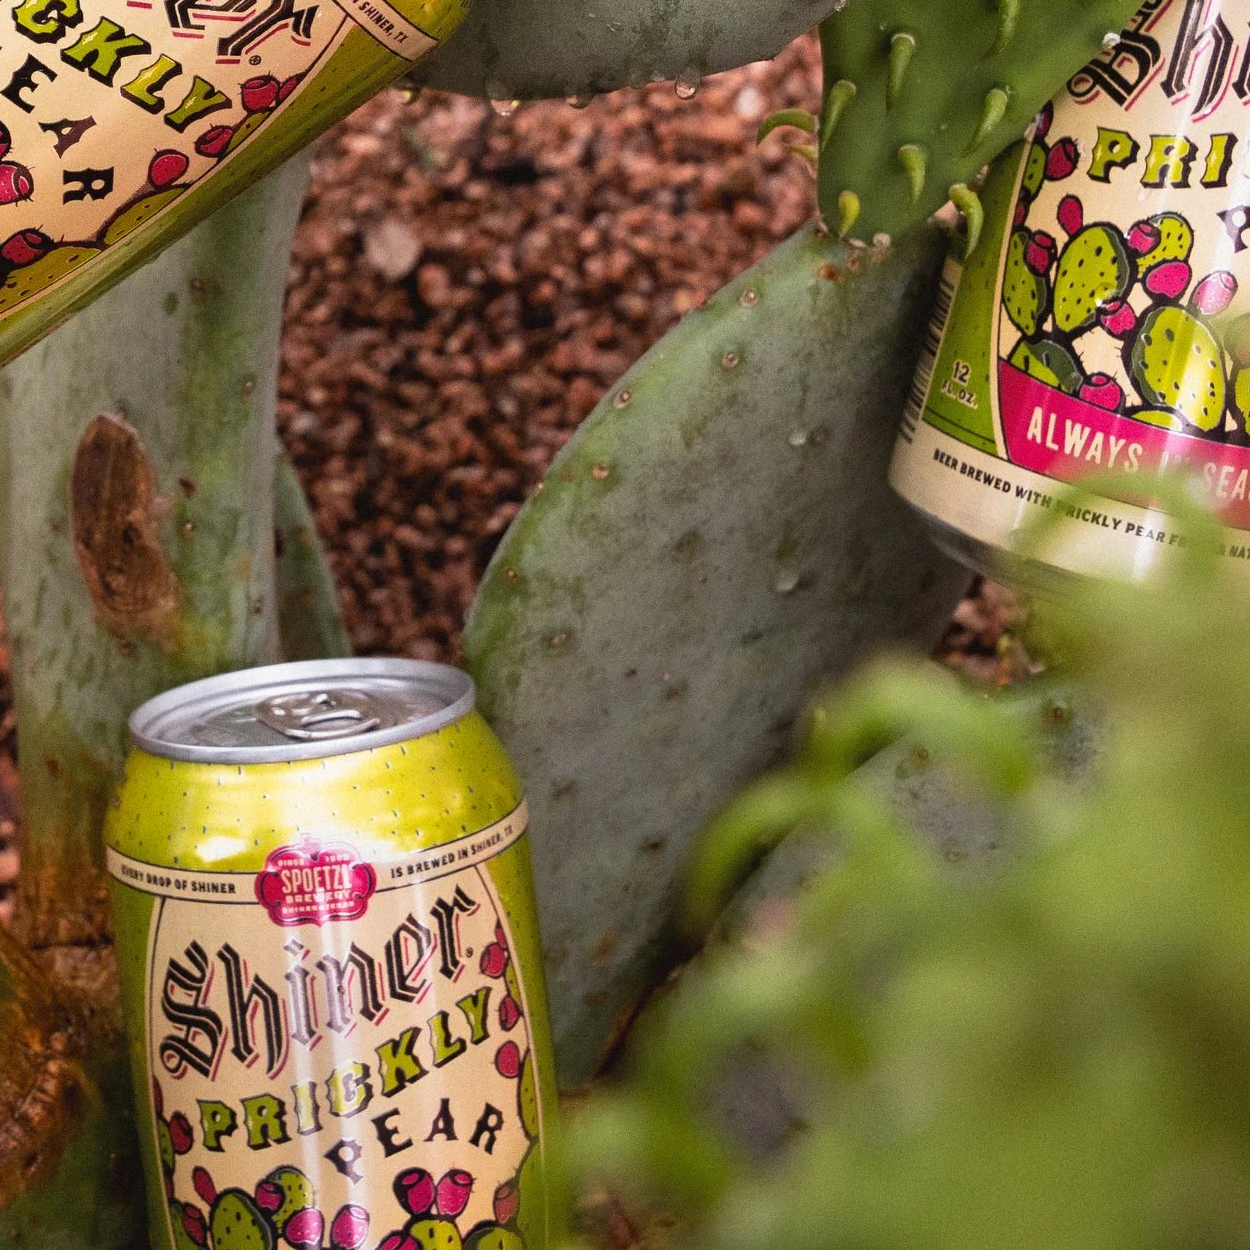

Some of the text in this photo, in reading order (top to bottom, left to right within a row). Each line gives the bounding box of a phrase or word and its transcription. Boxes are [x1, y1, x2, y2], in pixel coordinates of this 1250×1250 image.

[393, 31, 411, 45] TX
[953, 360, 971, 384] 12
[1026, 406, 1143, 474] ALWAYS
[1202, 461, 1250, 501] SEA
[933, 448, 959, 471] BEER
[959, 462, 1012, 494] BREWED
[1015, 485, 1051, 509] WITH
[1055, 498, 1122, 531] RICKLY
[1125, 521, 1166, 543] PEAR
[280, 863, 353, 894] SPOETZL
[390, 866, 403, 879] IS
[406, 852, 455, 876] BREWED
[457, 847, 469, 861] IN
[146, 873, 171, 888] DROP
[174, 878, 188, 891] OF
[191, 880, 236, 894] SHINER
[284, 889, 351, 904] BREWERY
[159, 884, 481, 1082] Shiner
[196, 985, 492, 1153] PRICKLY
[323, 1097, 504, 1185] PEAR
